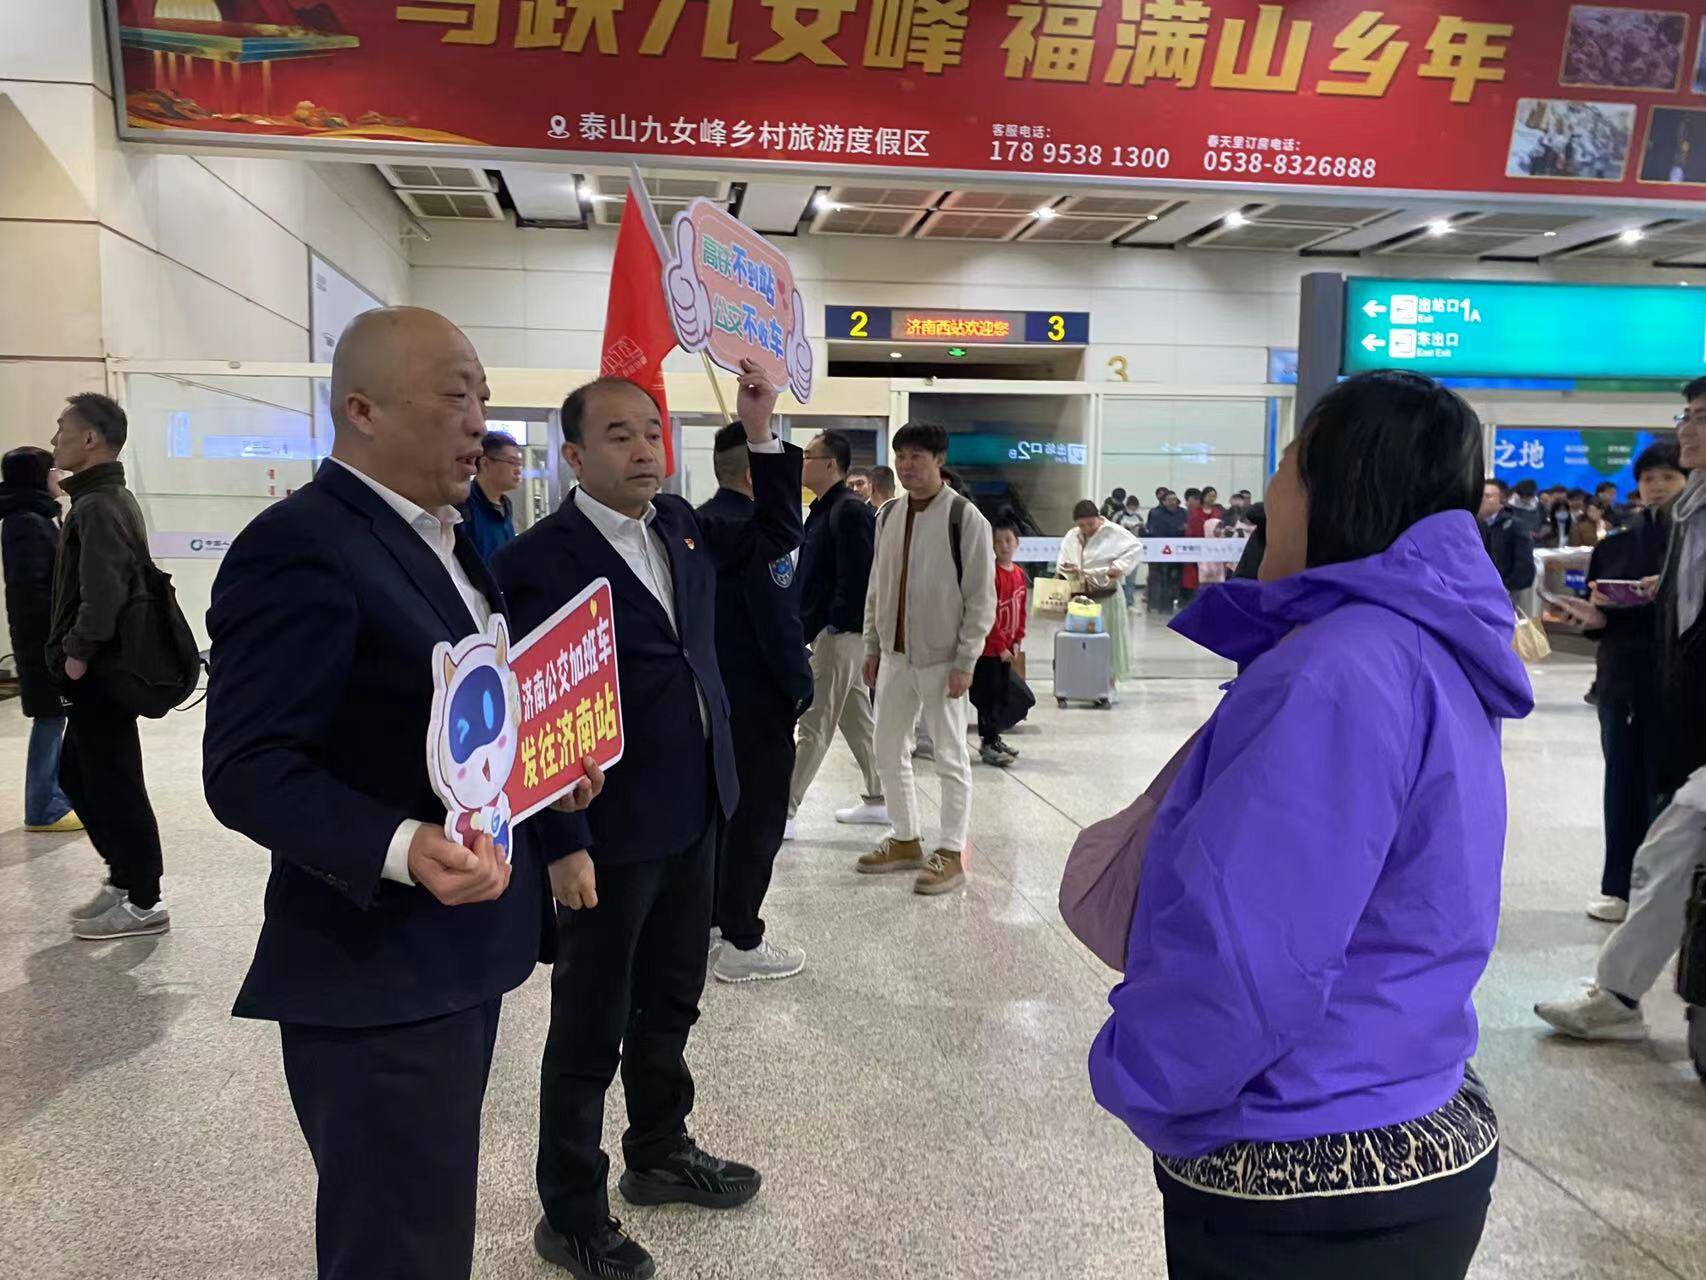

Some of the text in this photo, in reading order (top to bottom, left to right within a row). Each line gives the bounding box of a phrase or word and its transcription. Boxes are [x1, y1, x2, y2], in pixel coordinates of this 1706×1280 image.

[1000, 0, 1515, 104] 福满山乡年
[579, 112, 930, 157] 泰山九女峰乡村旅游度假区
[990, 141, 1170, 169] 178 9538 1300
[1203, 151, 1377, 178] 0538-8326888
[849, 311, 868, 337] 2
[906, 318, 1010, 337] 济南西站欢迎您
[1048, 315, 1066, 341] 3
[1108, 355, 1129, 382] 3
[521, 616, 613, 722] 济南公交加班车
[520, 682, 618, 790] 发往济南站
